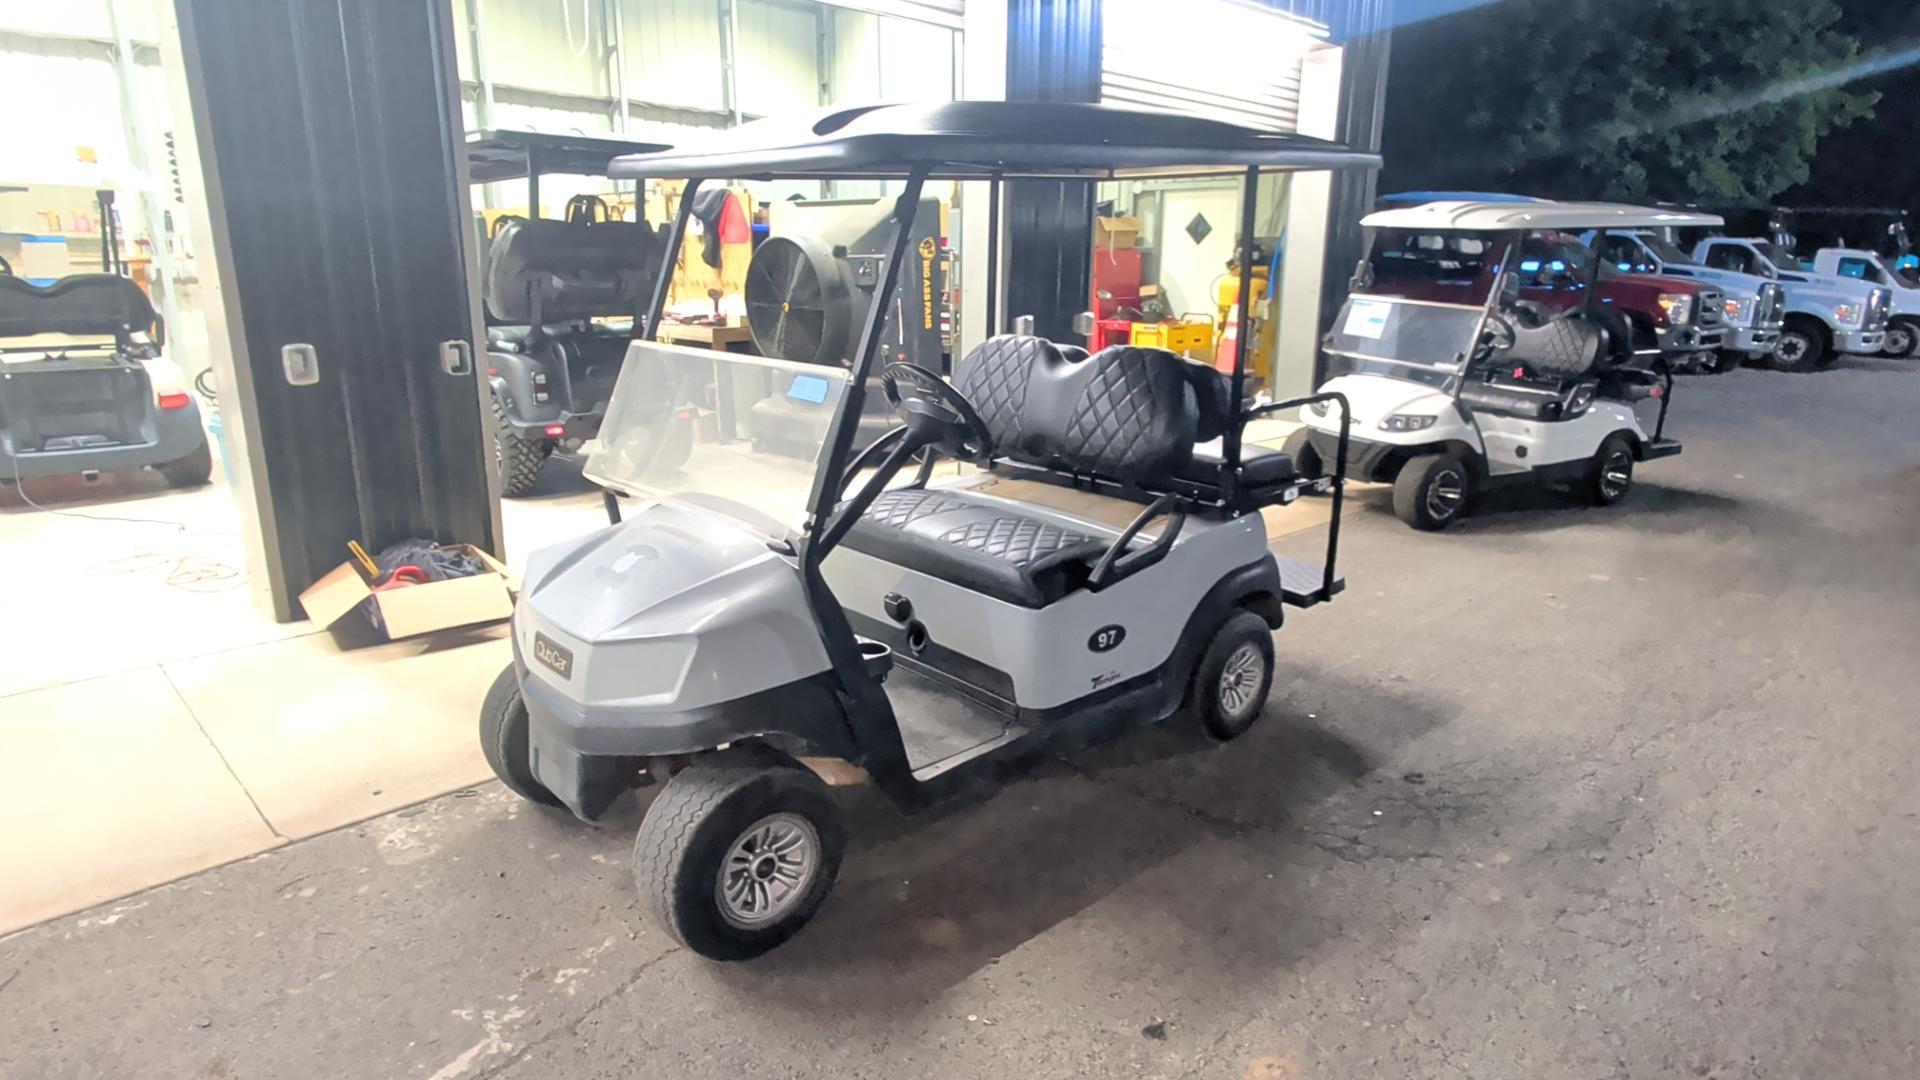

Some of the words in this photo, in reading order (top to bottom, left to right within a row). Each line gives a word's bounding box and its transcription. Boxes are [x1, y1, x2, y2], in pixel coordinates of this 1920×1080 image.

[923, 259, 931, 278] BIG
[923, 279, 931, 301] ASS
[924, 301, 933, 330] FANS
[1097, 629, 1118, 649] 97
